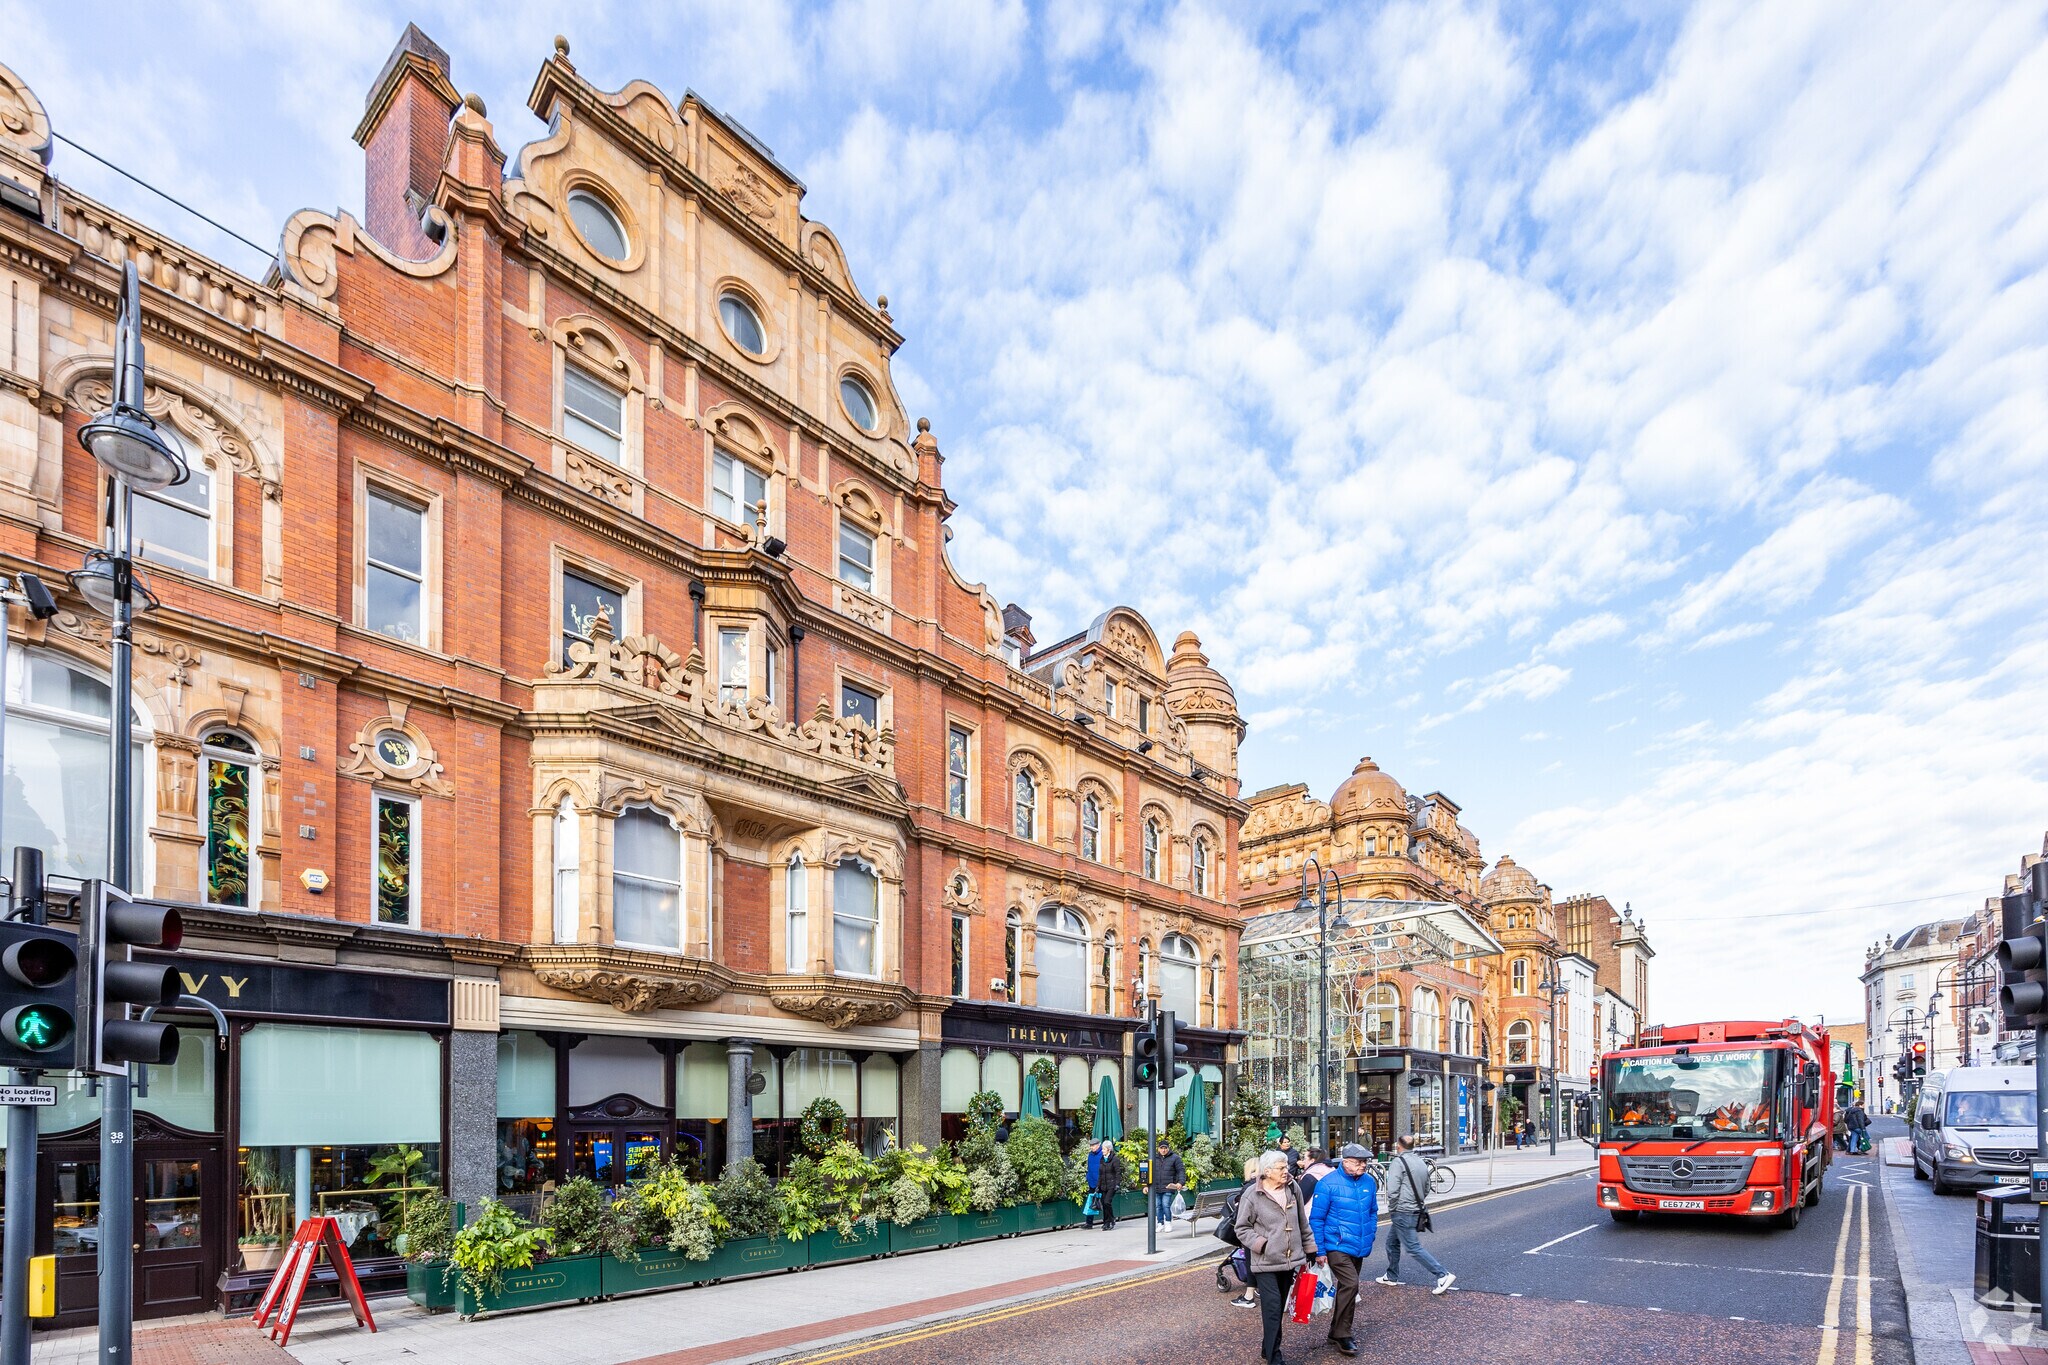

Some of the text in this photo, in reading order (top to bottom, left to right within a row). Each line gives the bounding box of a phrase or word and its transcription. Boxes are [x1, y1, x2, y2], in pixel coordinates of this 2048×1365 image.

[179, 972, 249, 998] VY
[1009, 1027, 1068, 1044] THE IVY
[1630, 1058, 1663, 1067] CAUTION
[1713, 1054, 1724, 1062] AT
[1725, 1053, 1751, 1061] WORK
[14, 1088, 51, 1096] loading
[110, 1131, 124, 1140] 38
[1685, 1201, 1701, 1209] ZPX
[662, 1261, 677, 1269] IVY
[515, 1277, 556, 1288] THE IVY
